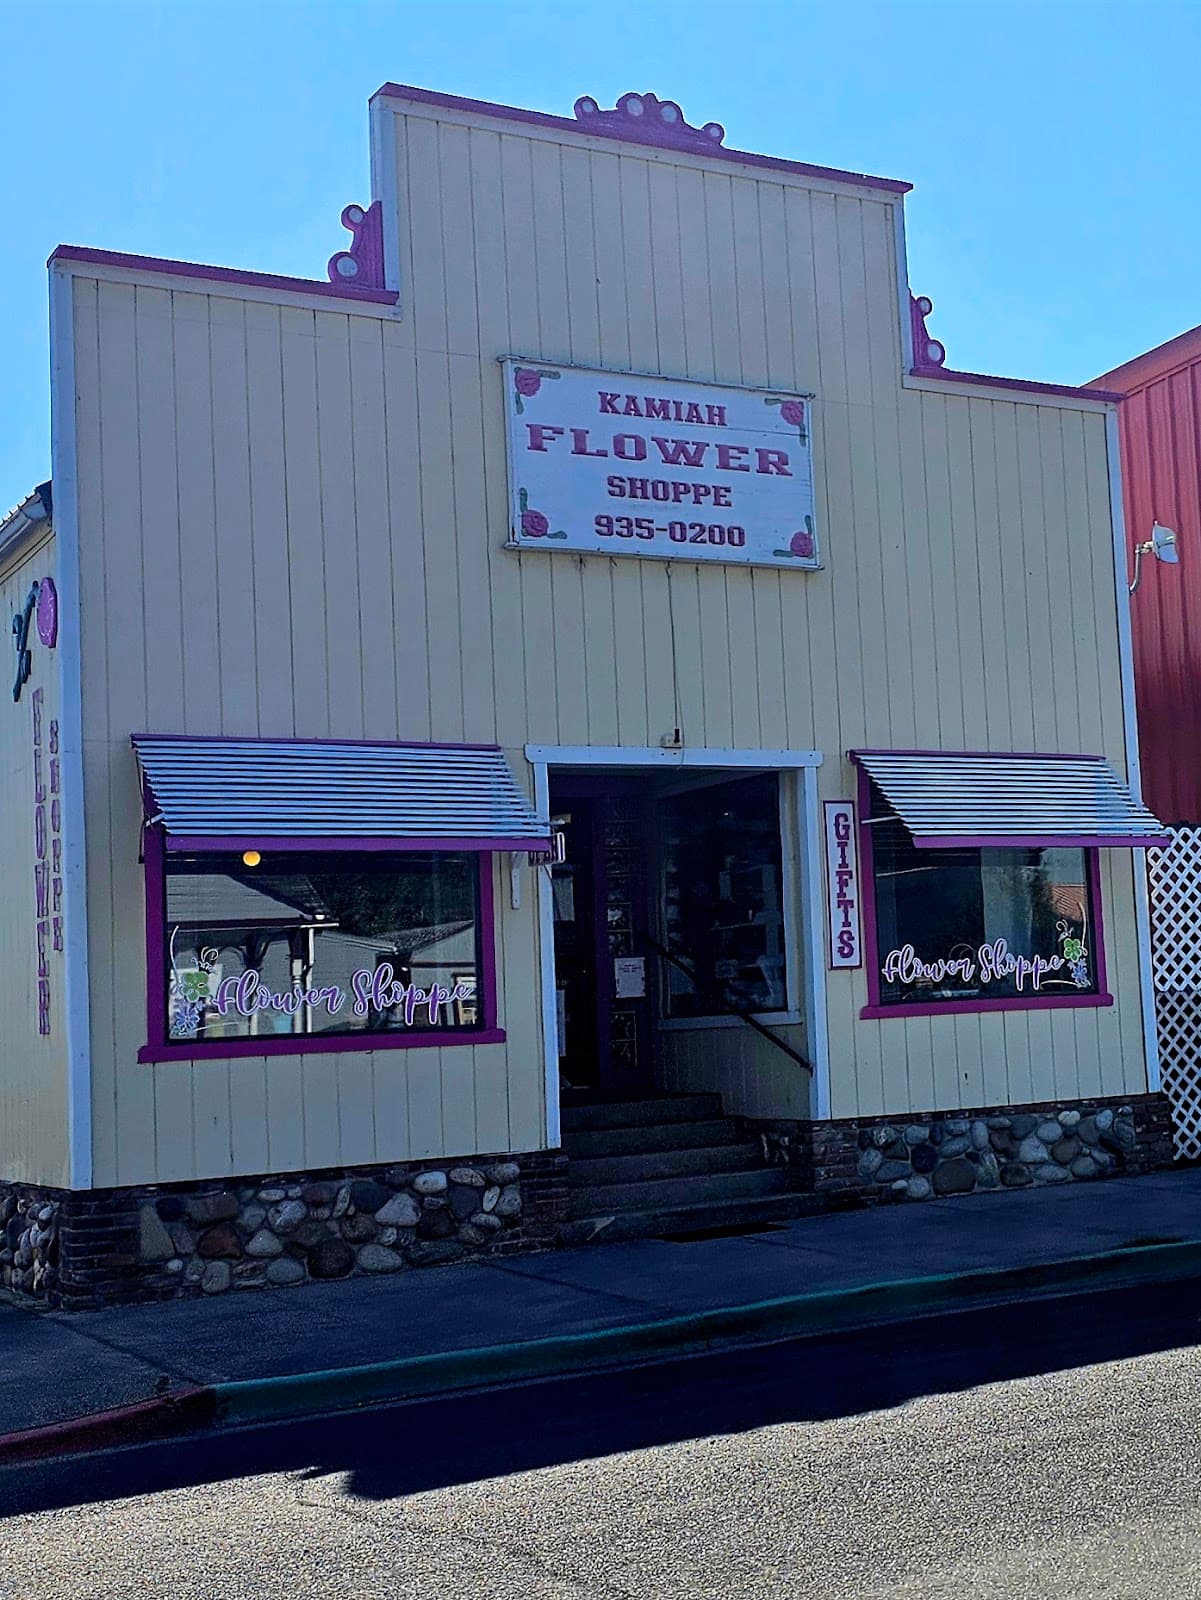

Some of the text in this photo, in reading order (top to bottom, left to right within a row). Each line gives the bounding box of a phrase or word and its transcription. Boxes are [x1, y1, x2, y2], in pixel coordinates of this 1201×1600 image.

[598, 391, 728, 427] KAMIAH
[525, 423, 793, 477] FLOWER
[606, 475, 732, 508] SHOPPE
[594, 514, 746, 547] 935-0200
[32, 687, 51, 1035] FLOWER
[49, 719, 64, 952] SHOPPE
[833, 812, 856, 959] GIFTS
[882, 938, 1066, 991] Flower Shoppe
[212, 962, 473, 1026] Flower Shoppe
